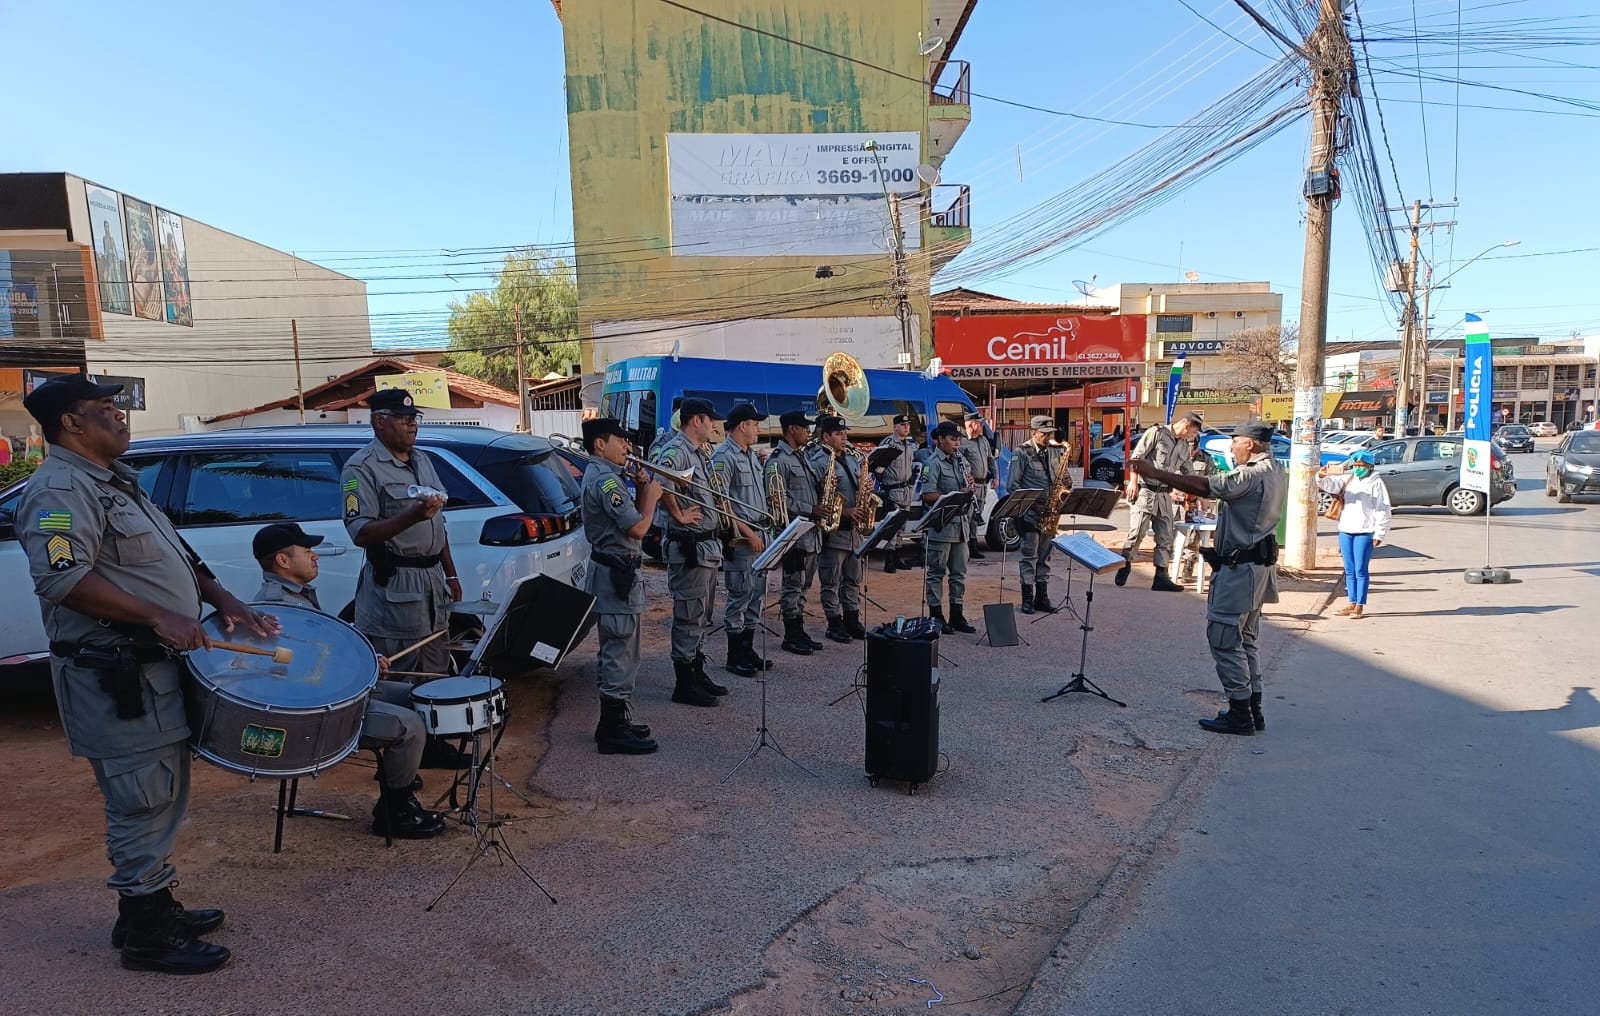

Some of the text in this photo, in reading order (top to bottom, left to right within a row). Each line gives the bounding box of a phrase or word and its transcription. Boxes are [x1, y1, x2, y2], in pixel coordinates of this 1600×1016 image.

[817, 143, 914, 153] IMPRESSÃ DIGITAL
[842, 156, 888, 165] E OFFSET
[817, 168, 914, 184] 3669-1000
[987, 336, 1066, 361] Cemil
[628, 367, 658, 381] MILITAR
[951, 366, 1130, 378] CASA DE CARNES E MERCEARIA
[1339, 401, 1382, 411] FIXTELL
